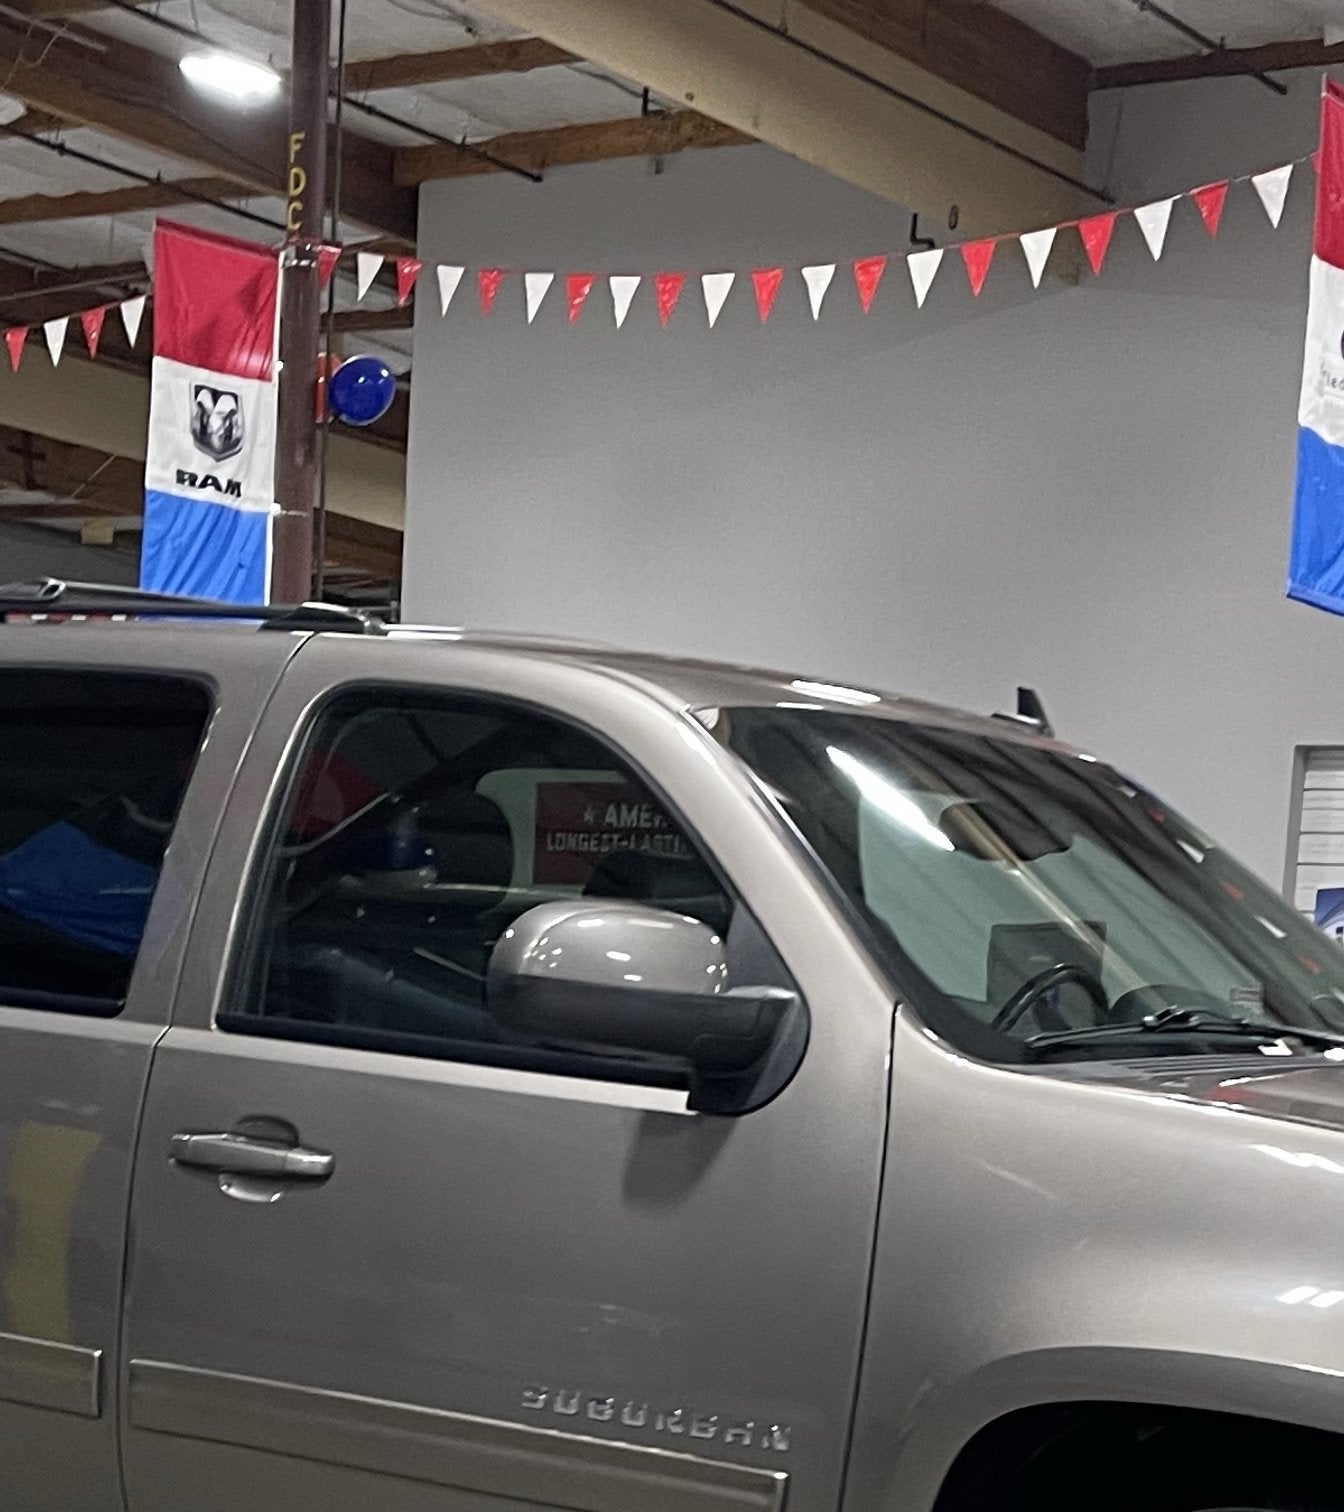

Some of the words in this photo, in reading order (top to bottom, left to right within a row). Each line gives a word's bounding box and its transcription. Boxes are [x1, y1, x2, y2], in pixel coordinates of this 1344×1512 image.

[287, 130, 306, 230] FDC
[175, 468, 242, 499] RAM
[520, 1385, 792, 1451] SUBURBAN
